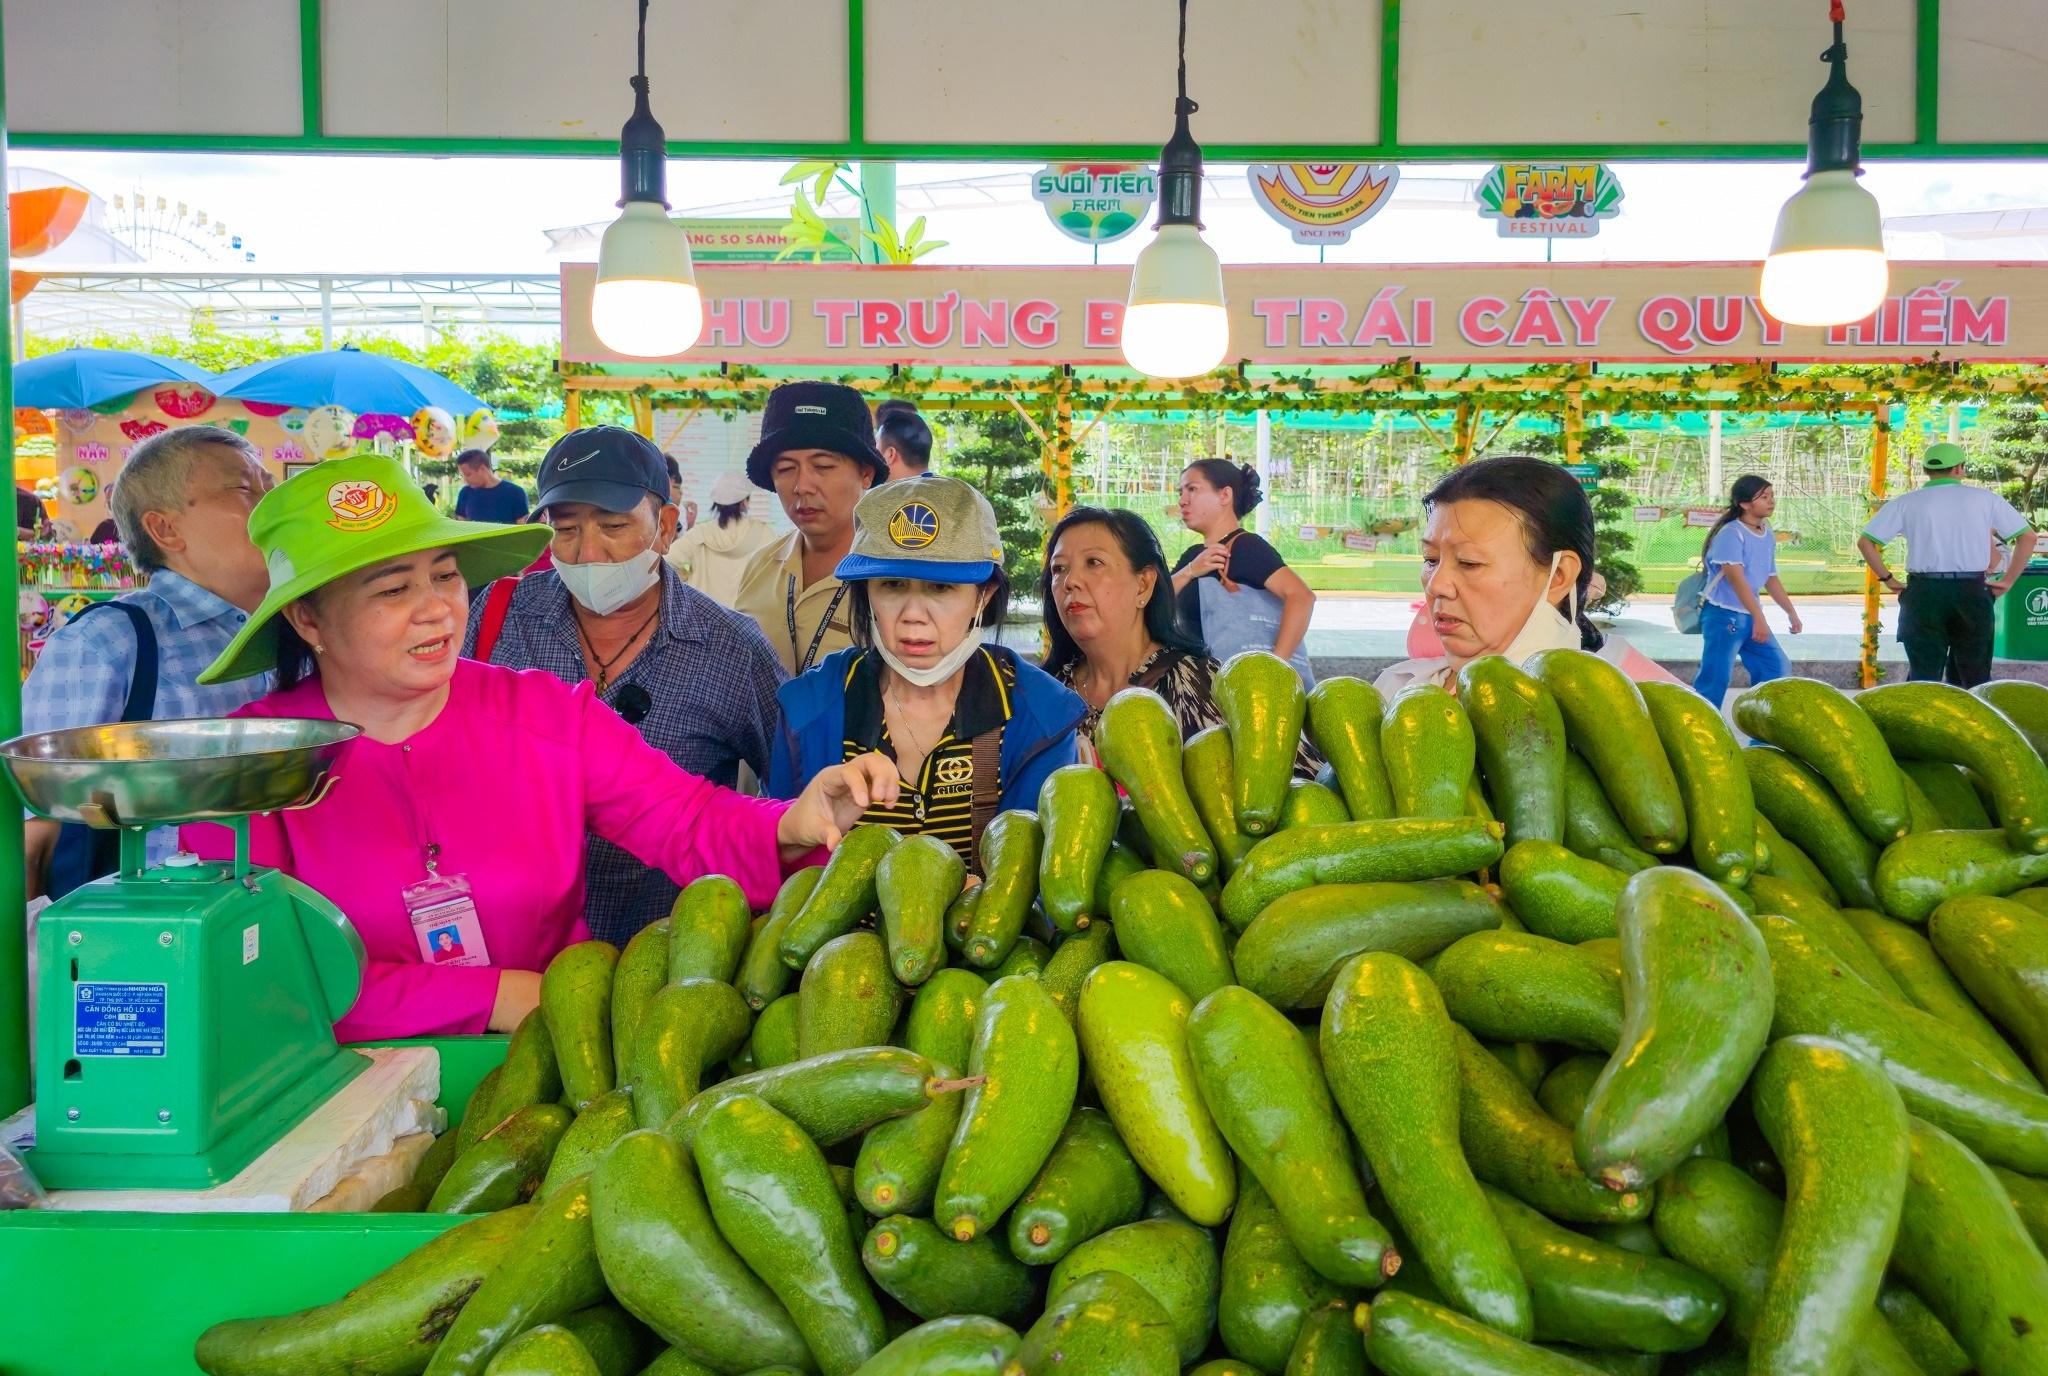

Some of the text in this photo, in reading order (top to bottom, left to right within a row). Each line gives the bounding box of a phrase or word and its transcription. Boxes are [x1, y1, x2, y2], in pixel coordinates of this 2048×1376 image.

[1039, 168, 1091, 193] SUỐI
[1503, 164, 1597, 201] FARM
[1072, 198, 1121, 211] FARM
[1317, 210, 1344, 219] THEME
[1344, 199, 1365, 214] PARK
[1299, 229, 1346, 237] SINCE 1995
[1510, 222, 1588, 233] FESTIVAL
[720, 234, 740, 245] SO
[700, 299, 791, 348] HU
[813, 289, 1061, 349] TRƯNG
[1252, 284, 1436, 347] TRÁI
[1458, 286, 1616, 347] CÂY
[937, 783, 972, 795] GUCC
